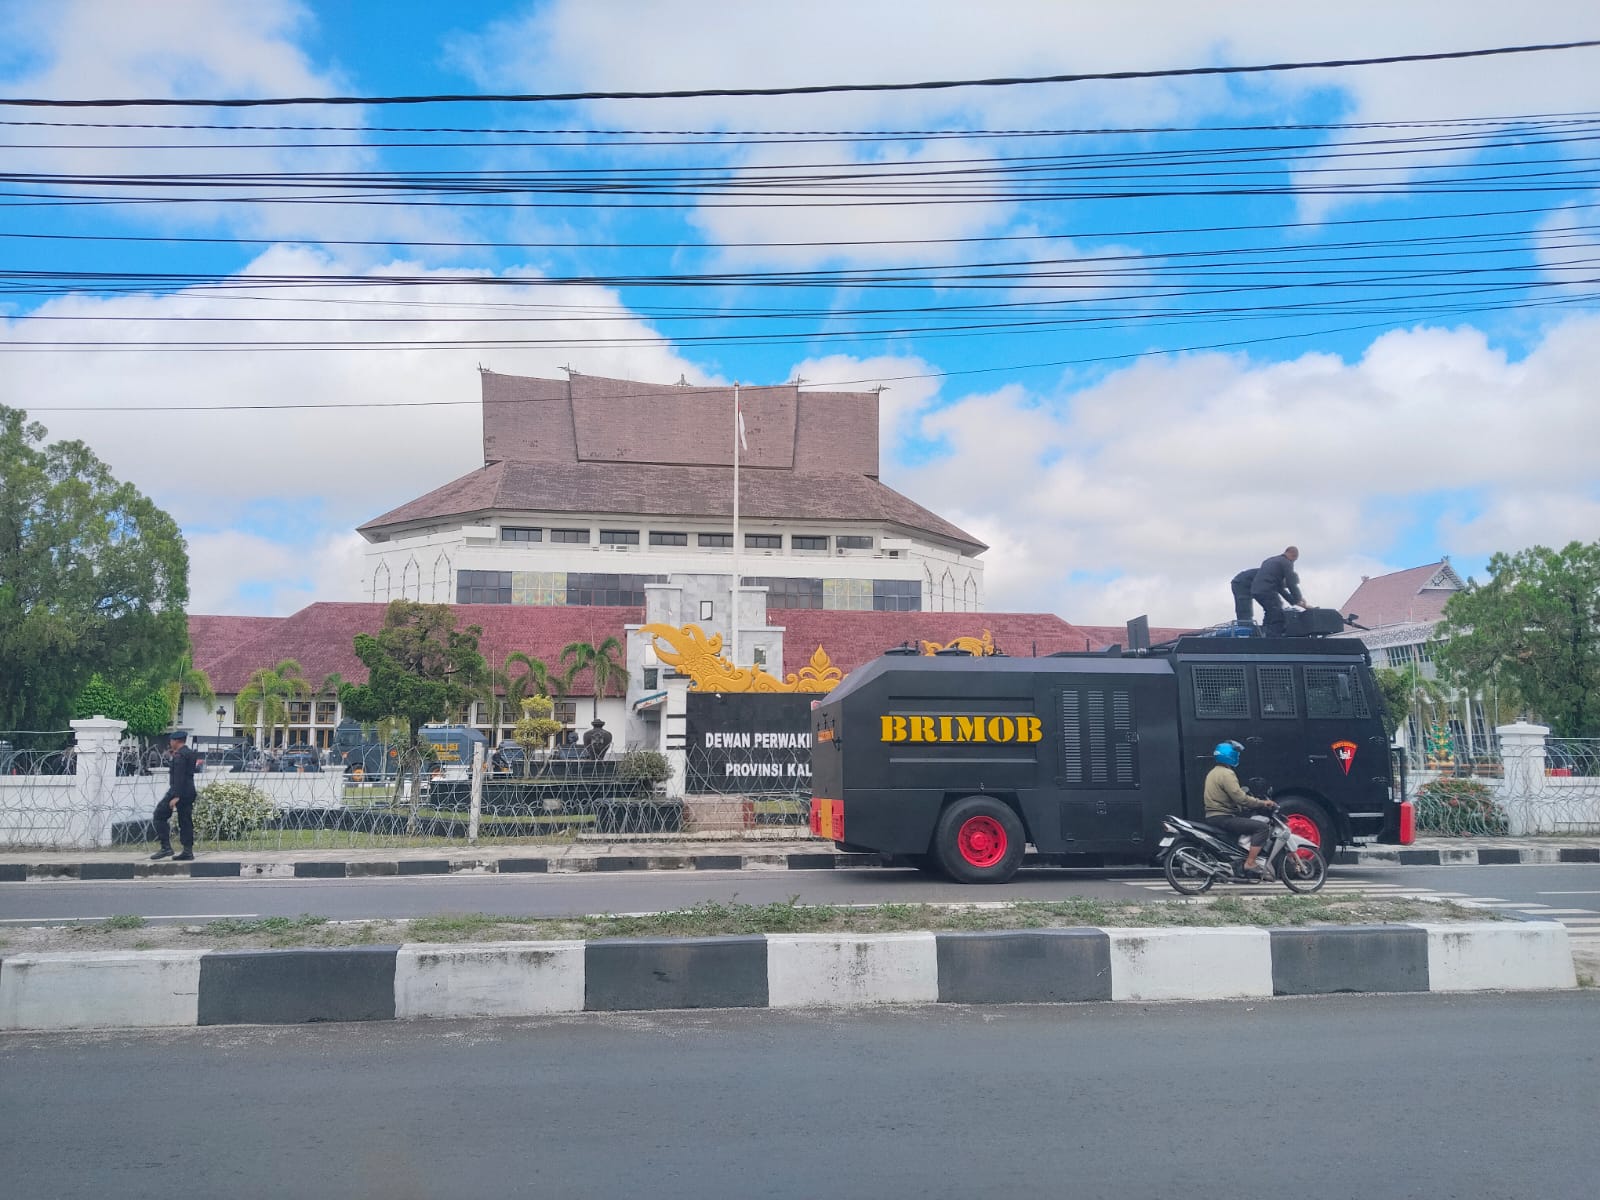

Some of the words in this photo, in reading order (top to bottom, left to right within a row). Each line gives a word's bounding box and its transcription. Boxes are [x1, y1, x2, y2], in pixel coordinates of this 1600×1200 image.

[880, 715, 1043, 743] BRIMOB
[430, 743, 459, 751] OLISI
[705, 732, 751, 748] DEWAN
[754, 732, 813, 749] PERWAKI
[725, 763, 783, 777] PROVINSI
[787, 763, 813, 777] KAL
